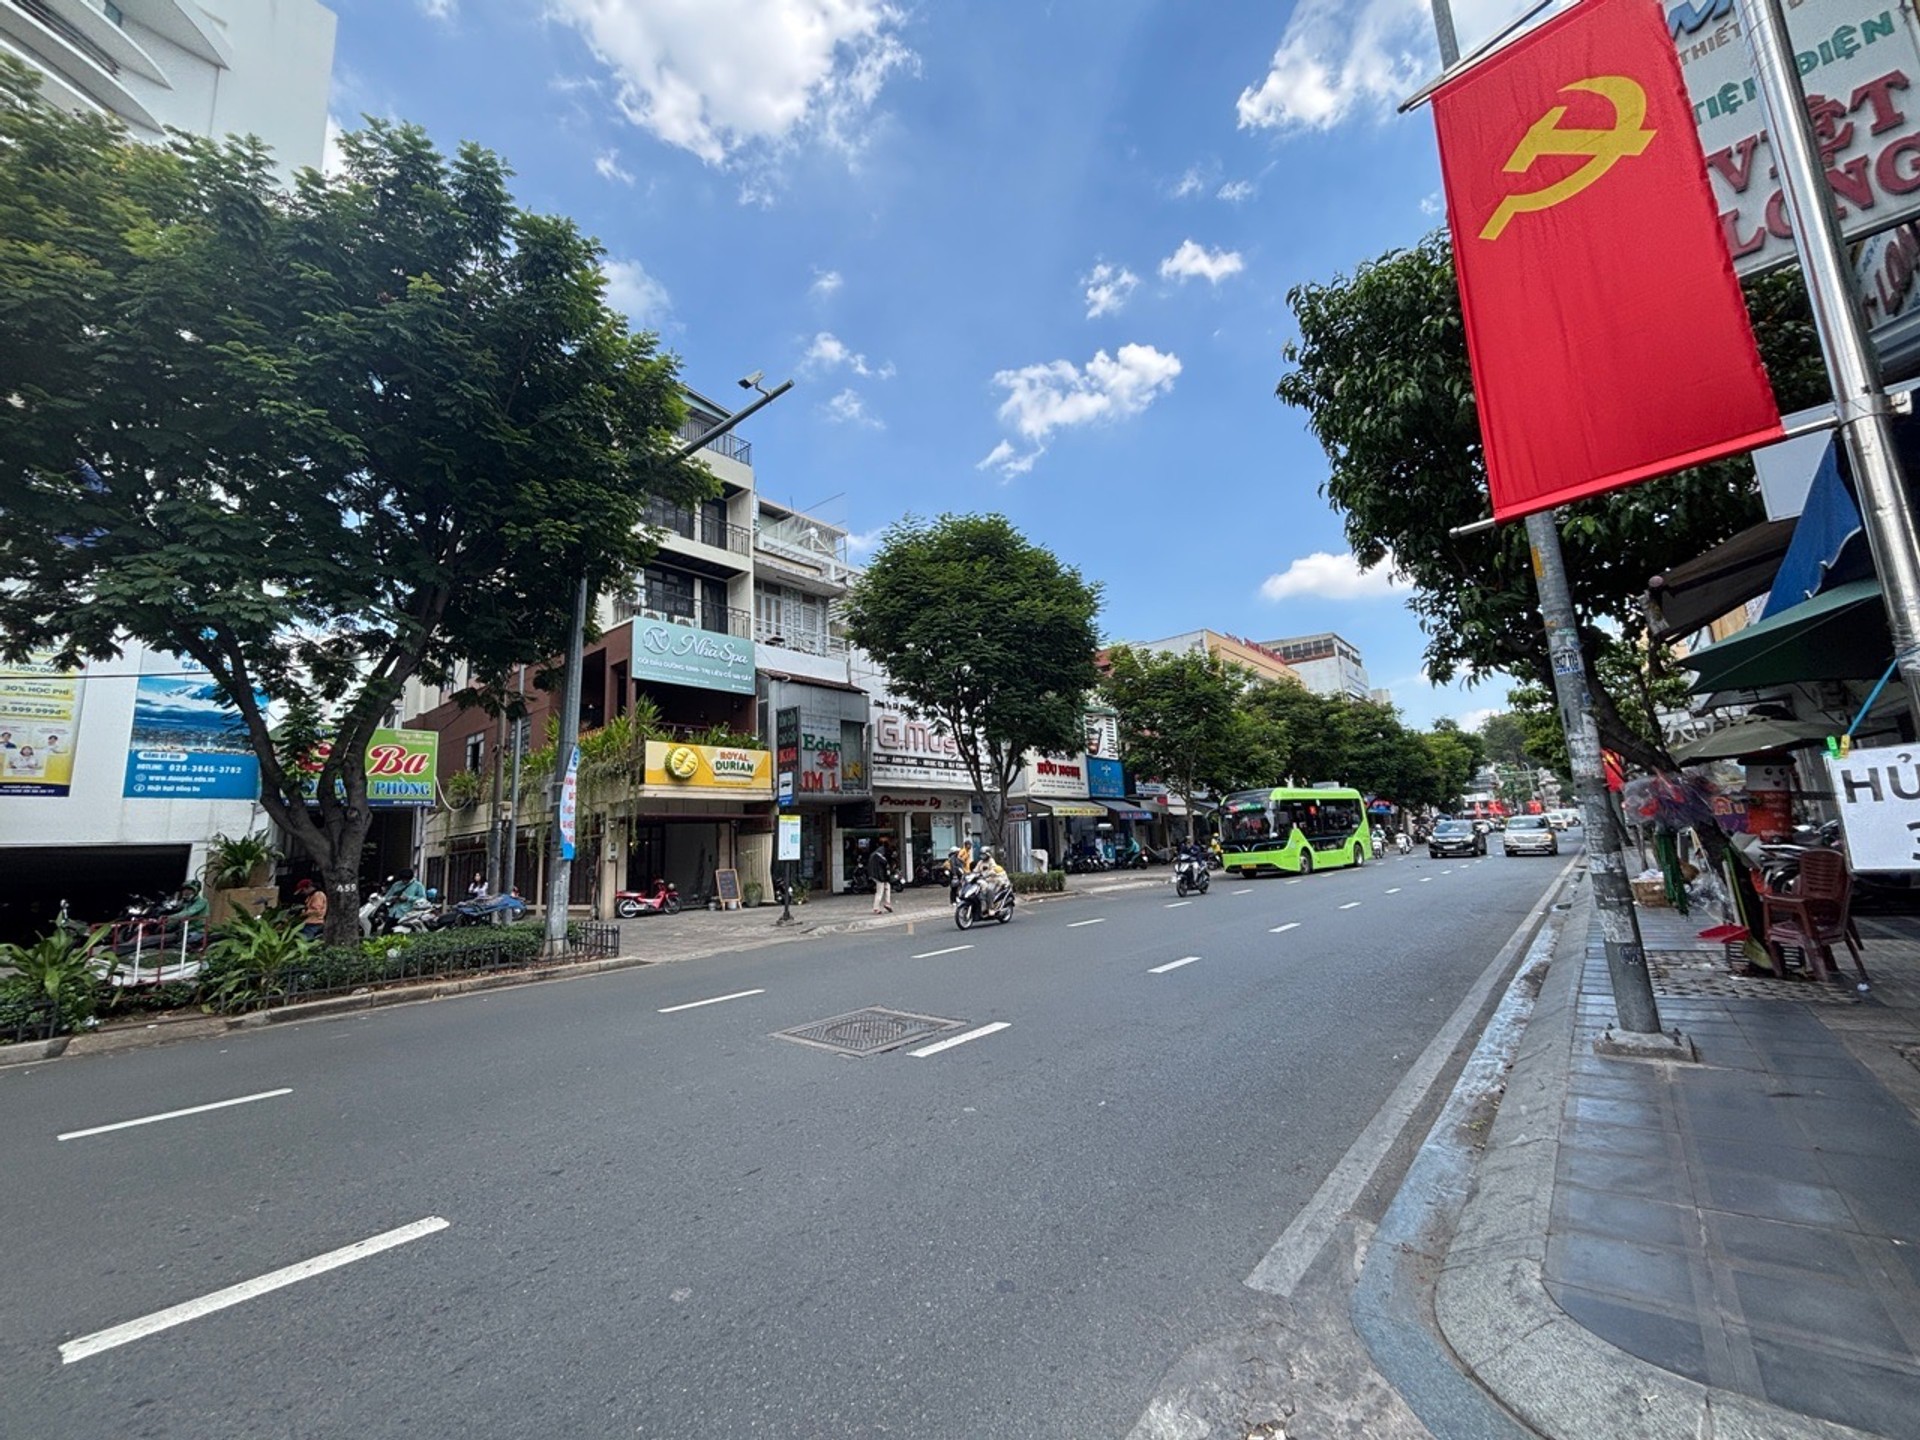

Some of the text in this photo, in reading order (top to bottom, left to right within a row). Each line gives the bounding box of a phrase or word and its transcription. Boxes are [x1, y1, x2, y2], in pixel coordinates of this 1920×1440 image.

[1678, 21, 1742, 66] THIẾT
[1797, 10, 1895, 77] ĐIỆN
[1706, 69, 1910, 194] VỆT
[719, 642, 749, 667] Spa
[802, 733, 842, 751] Eden
[368, 744, 430, 776] Ba
[715, 760, 755, 773] DURIAN
[720, 751, 749, 761] ROYAL
[374, 777, 431, 796] PHÒNG
[879, 795, 927, 806] Pioneer
